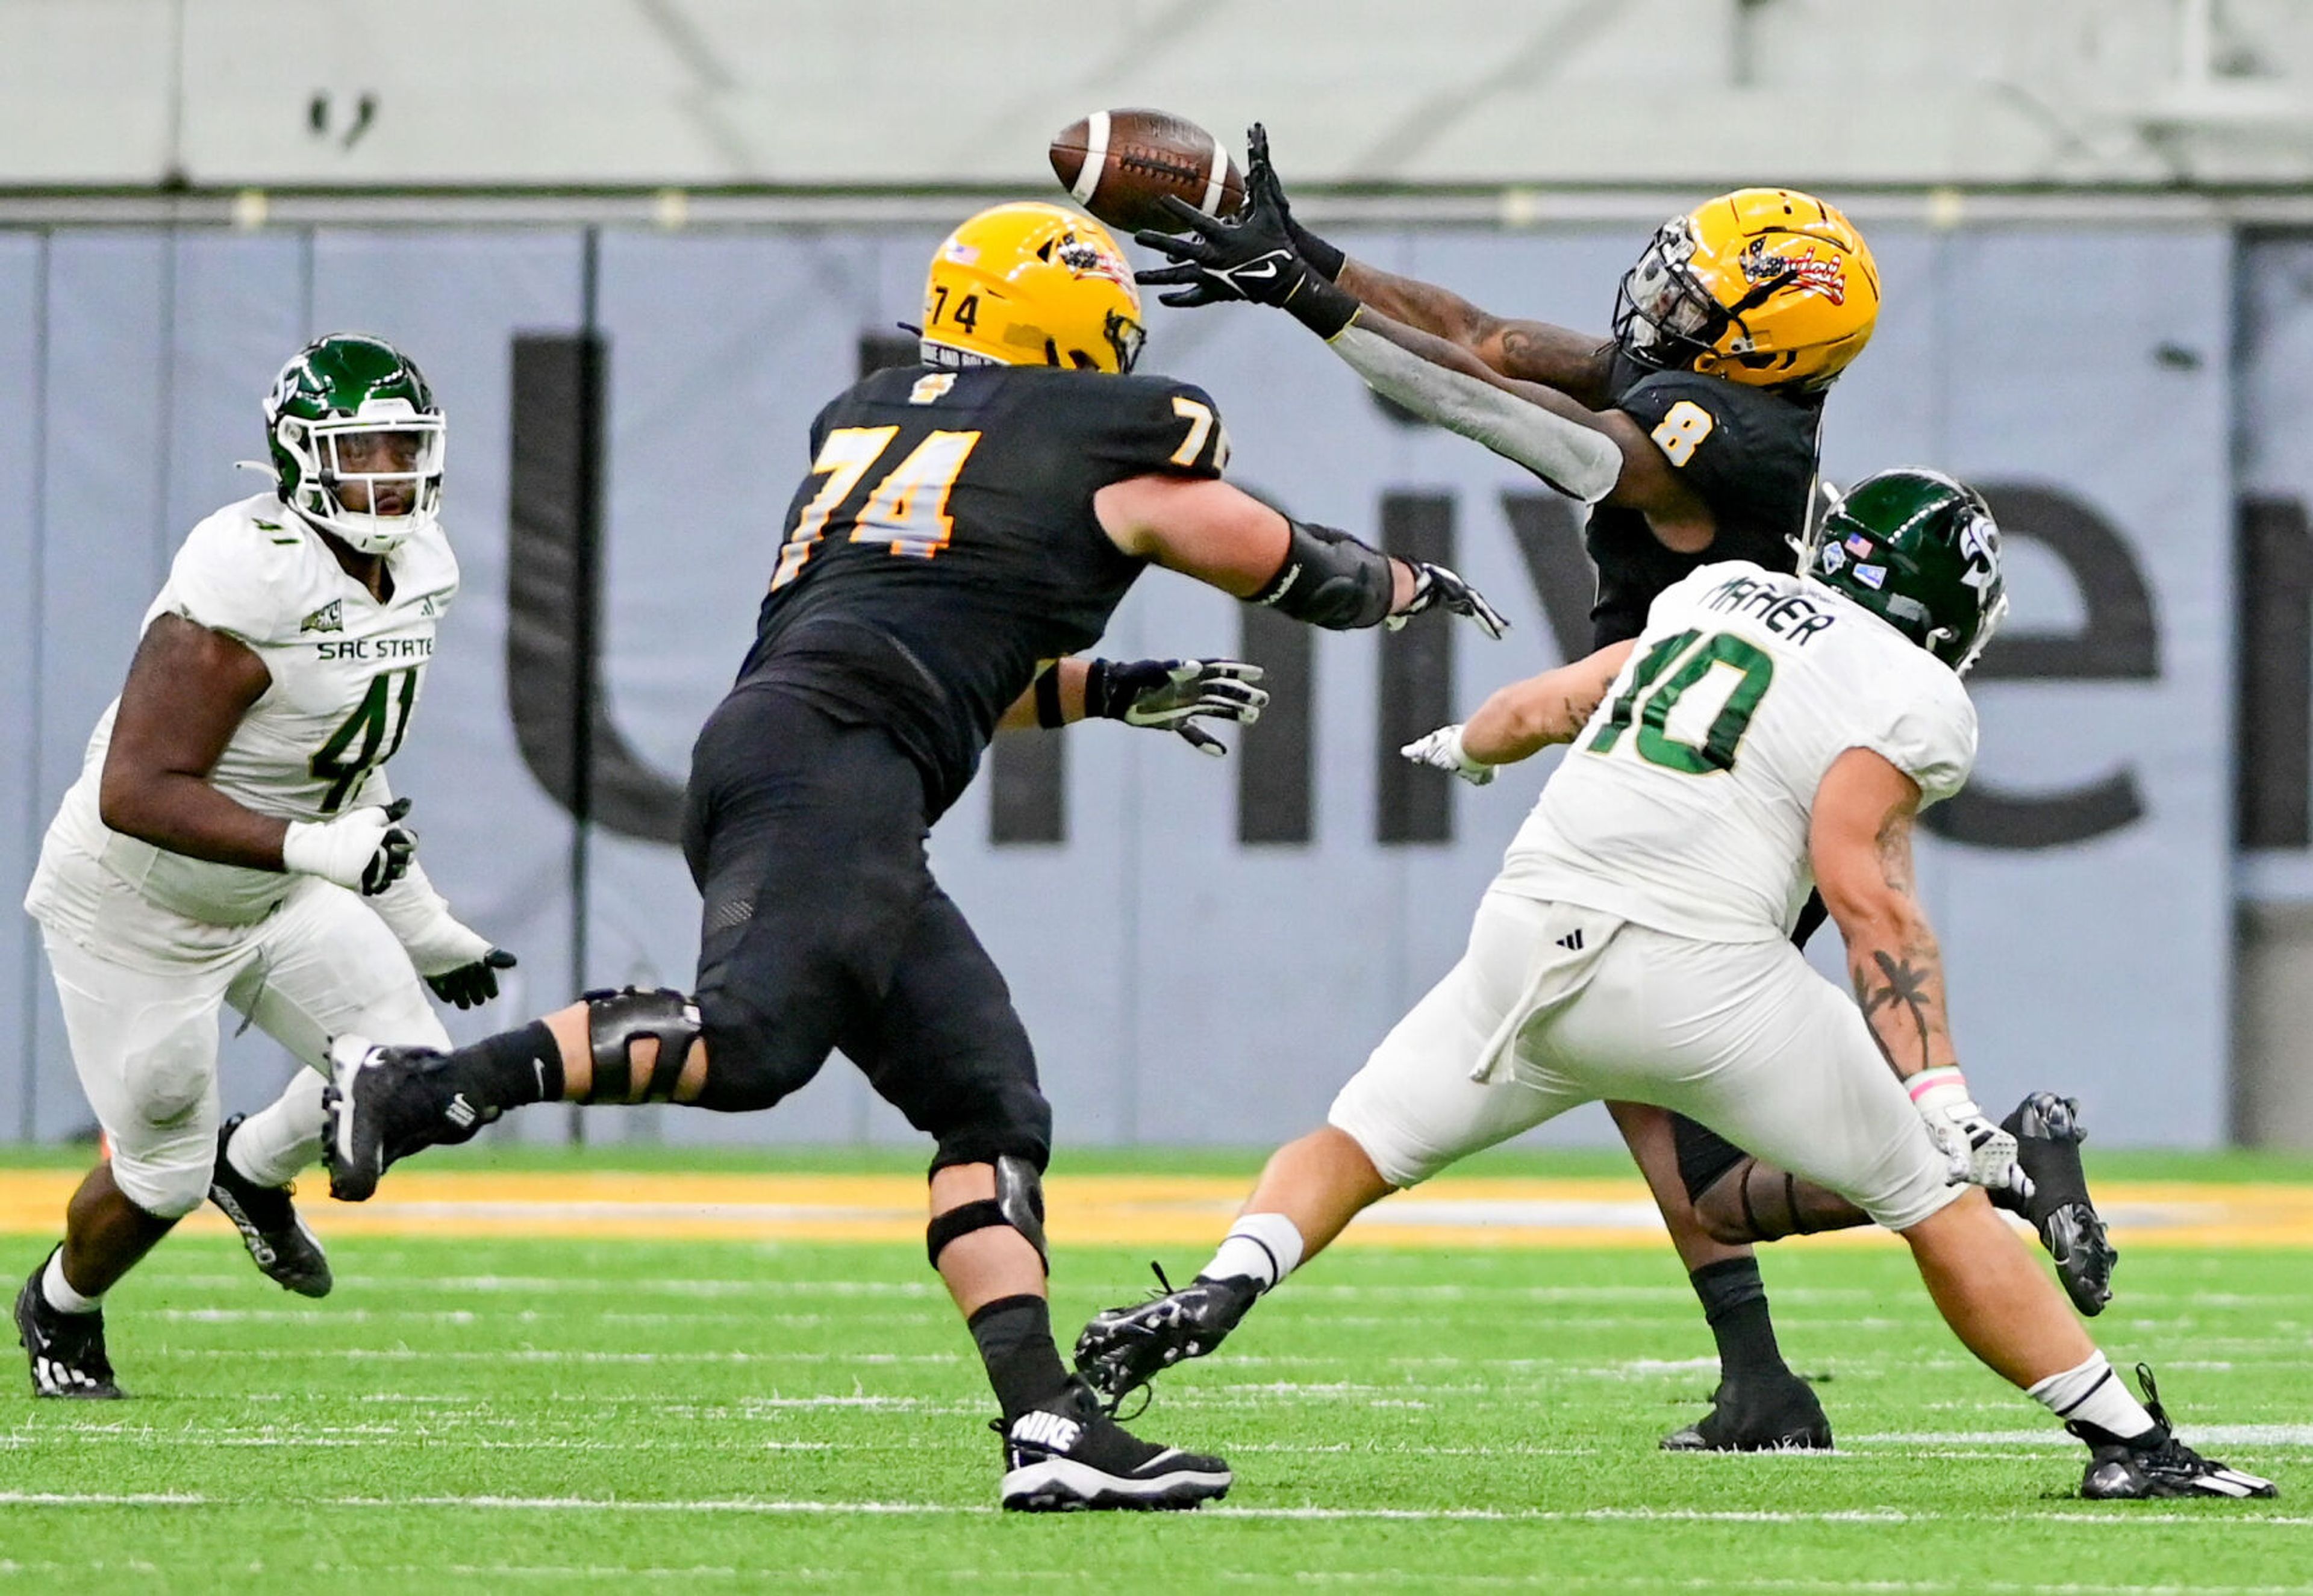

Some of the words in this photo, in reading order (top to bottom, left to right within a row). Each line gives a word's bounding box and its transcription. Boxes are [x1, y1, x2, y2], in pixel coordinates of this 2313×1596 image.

[932, 285, 979, 334] 74
[1650, 401, 1713, 467] 8
[770, 425, 982, 592] 74
[317, 640, 369, 660] SAC
[376, 637, 433, 658] STATE
[1585, 626, 1775, 776] 10
[308, 664, 417, 813] 41
[1010, 1409, 1081, 1452] NIKE
